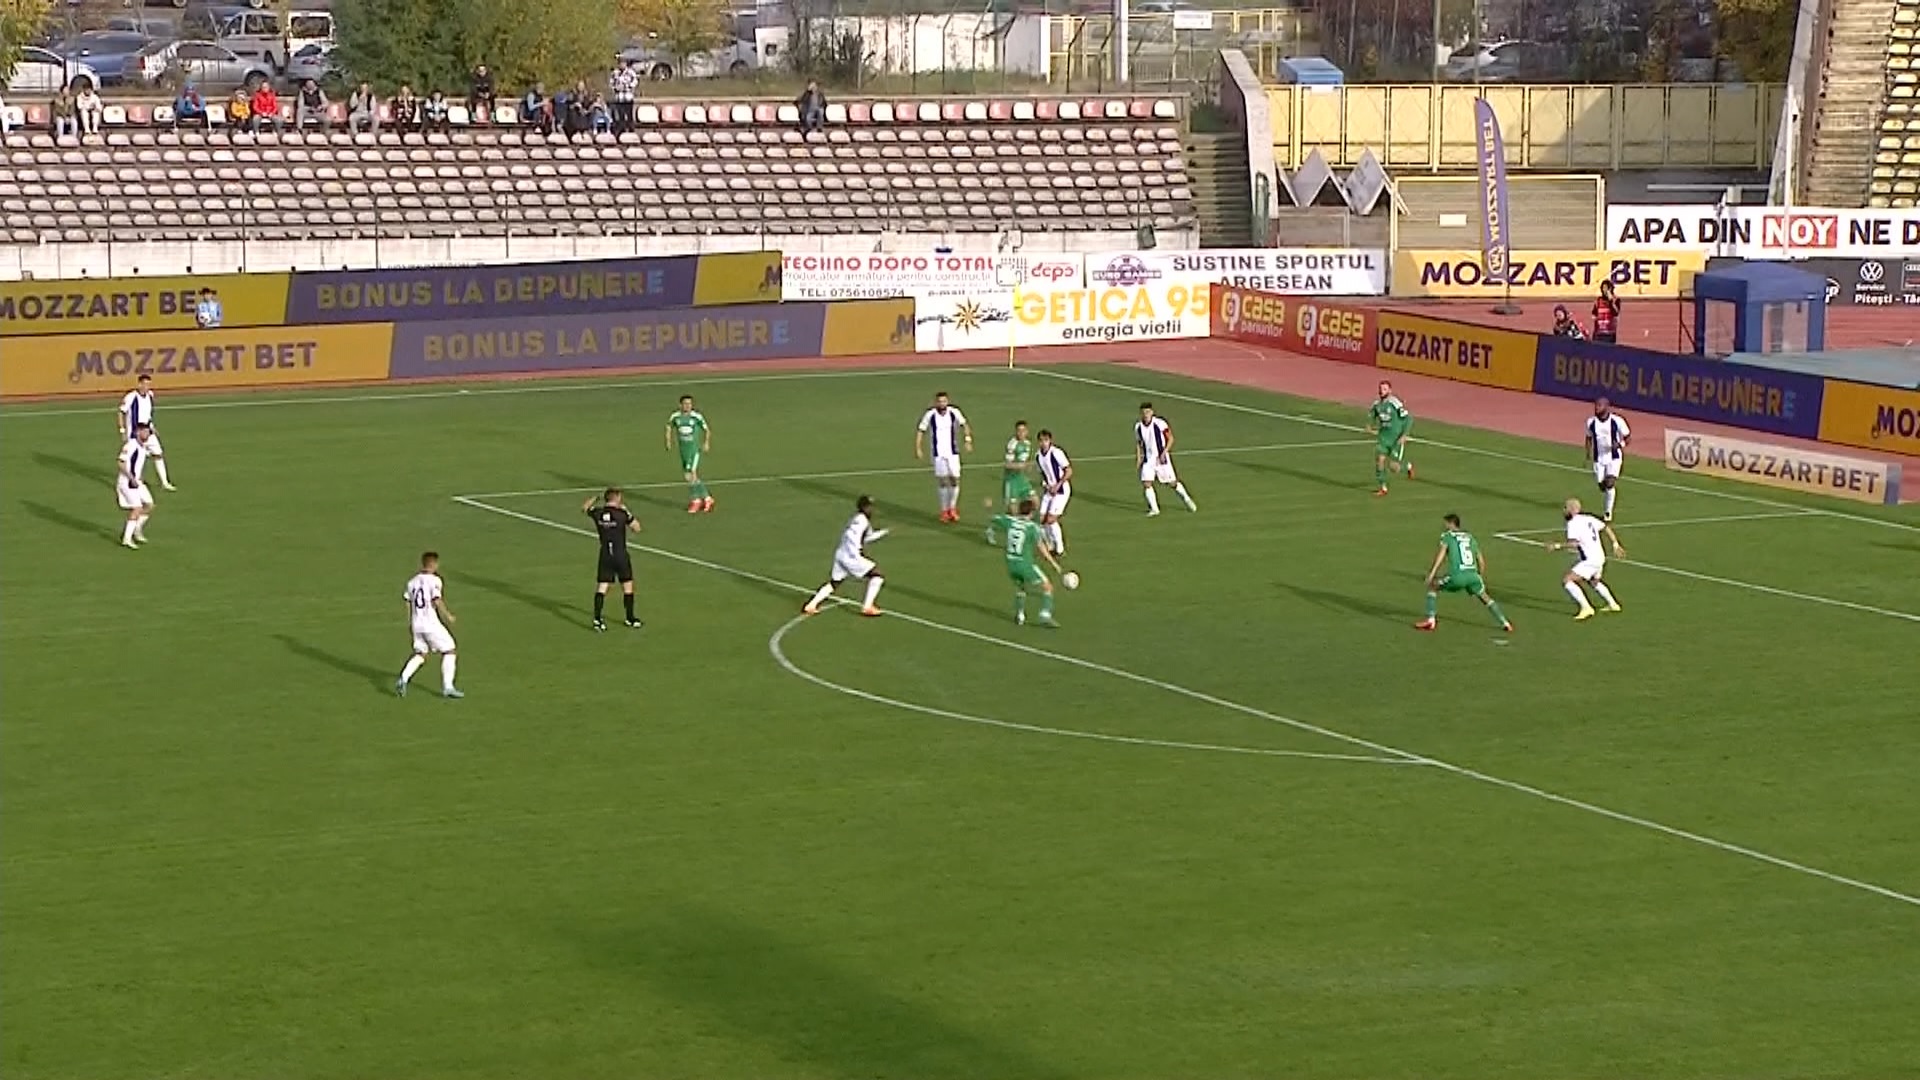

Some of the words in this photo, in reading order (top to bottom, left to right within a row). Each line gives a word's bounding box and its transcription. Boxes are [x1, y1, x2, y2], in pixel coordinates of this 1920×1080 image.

[1619, 218, 1686, 243] APA
[1700, 218, 1751, 244] DIN
[1765, 217, 1834, 246] NOY
[1850, 219, 1891, 245] NE
[782, 256, 862, 271] TECHNO
[868, 256, 928, 271] DOPO
[935, 256, 994, 271] TOTAL
[1275, 254, 1376, 270] SPORTUL
[1611, 260, 1677, 285] BET
[316, 280, 433, 310] BONUS
[443, 279, 484, 303] LA
[1018, 286, 1156, 325] GETICA
[1166, 284, 1210, 317] 95
[1242, 295, 1285, 323] casa
[1061, 324, 1133, 340] energia
[1319, 308, 1365, 339] casa
[423, 330, 545, 361] BONUS
[557, 328, 598, 355] LA
[1458, 340, 1493, 369] BET
[71, 344, 246, 380] MOZZART
[255, 342, 317, 370] BET
[1554, 354, 1630, 392] BONUS
[1636, 366, 1664, 396] LA
[1458, 541, 1474, 565] 6
